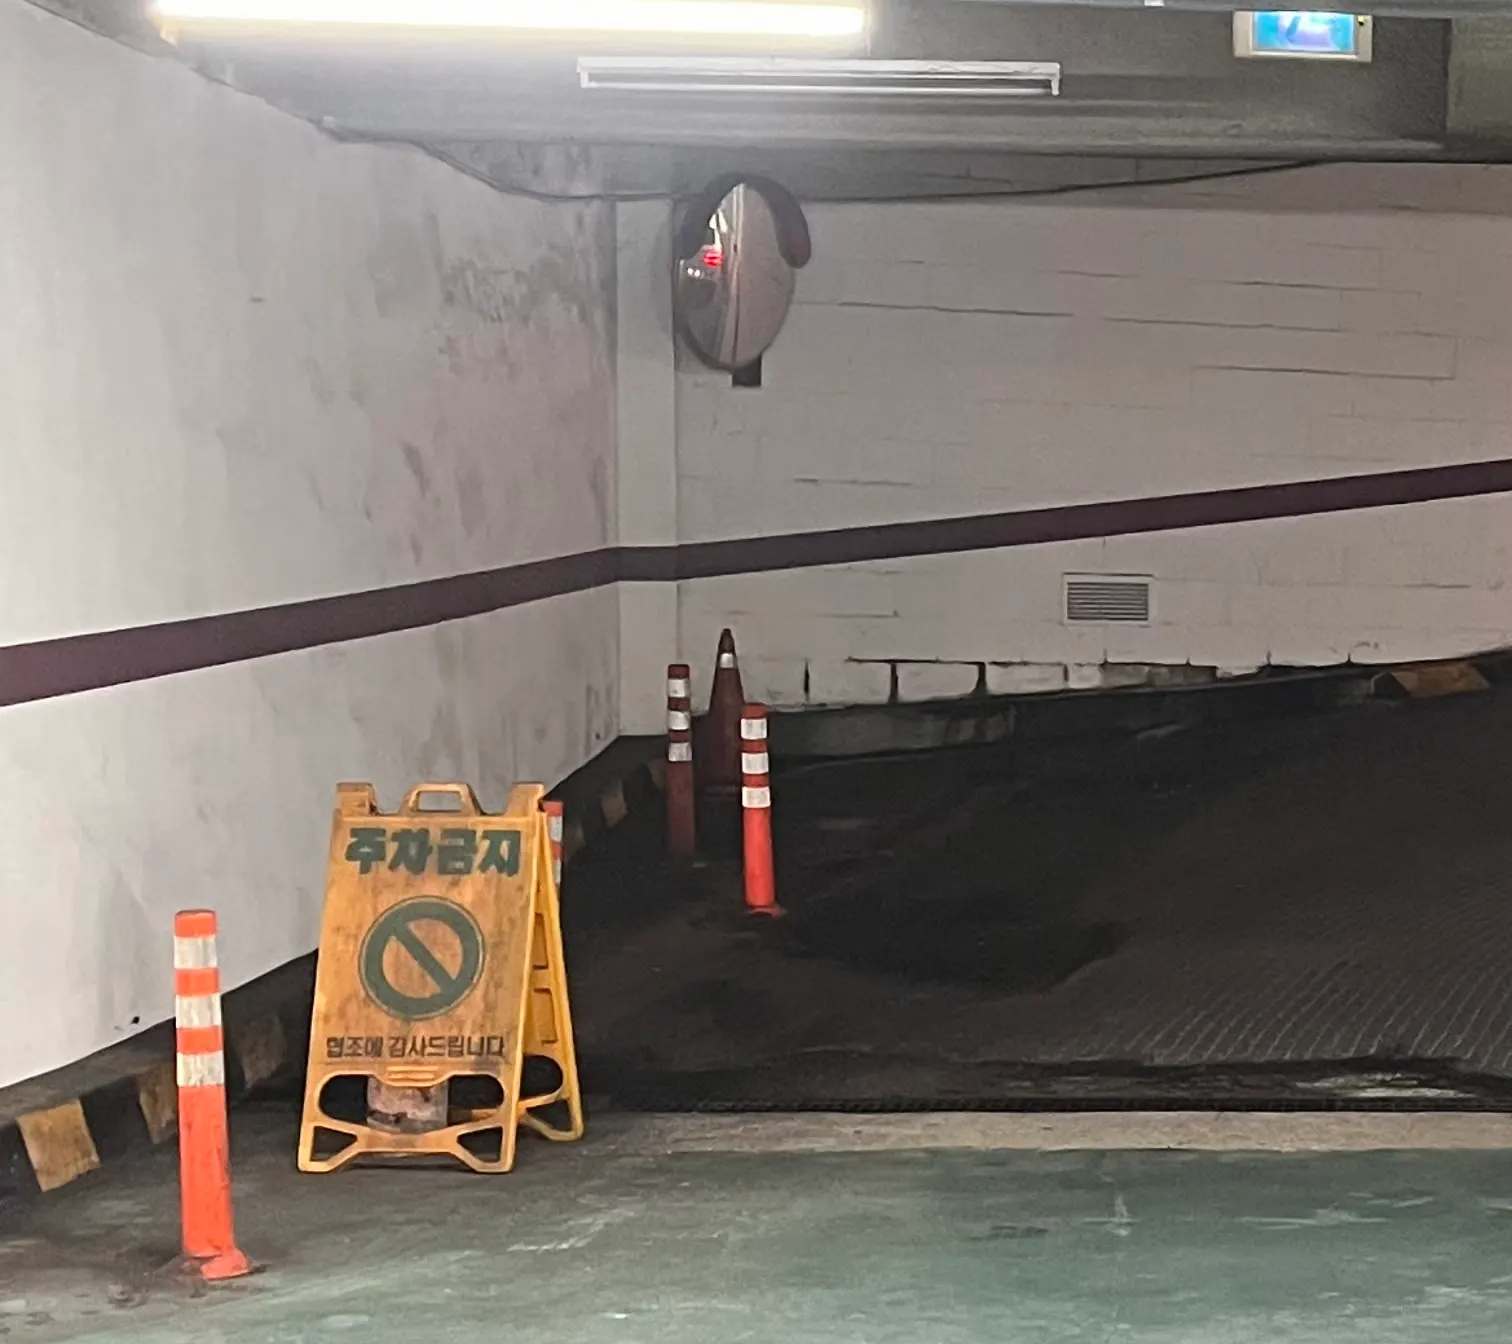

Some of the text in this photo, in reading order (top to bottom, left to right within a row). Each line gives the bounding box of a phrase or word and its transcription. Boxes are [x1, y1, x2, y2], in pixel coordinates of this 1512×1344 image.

[344, 827, 522, 877] 주차금지
[326, 1035, 505, 1058] 협조에 감사드립니다
